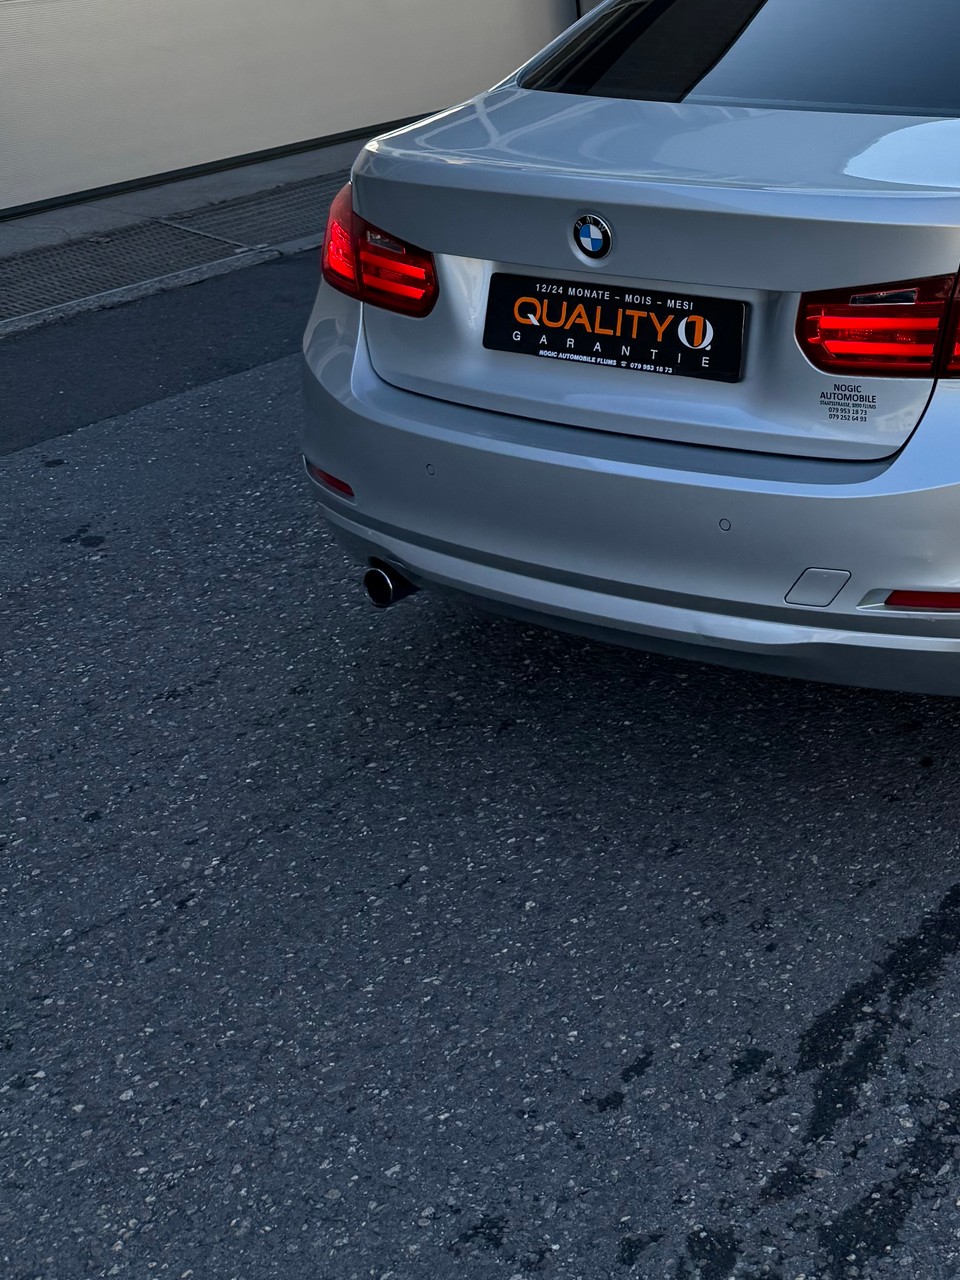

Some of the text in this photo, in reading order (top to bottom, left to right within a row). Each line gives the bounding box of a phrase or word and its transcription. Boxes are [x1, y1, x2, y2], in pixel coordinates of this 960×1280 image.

[536, 284, 563, 294] 12/24
[568, 287, 610, 300] MONATE
[625, 294, 652, 304] MOIS
[667, 300, 693, 310] MESI
[514, 296, 674, 342] QUALITY
[513, 331, 709, 367] GARANTIE
[558, 353, 595, 363] AUTOMOBILE
[820, 392, 876, 403] AUTOMOBILE
[834, 384, 861, 393] NOGIC
